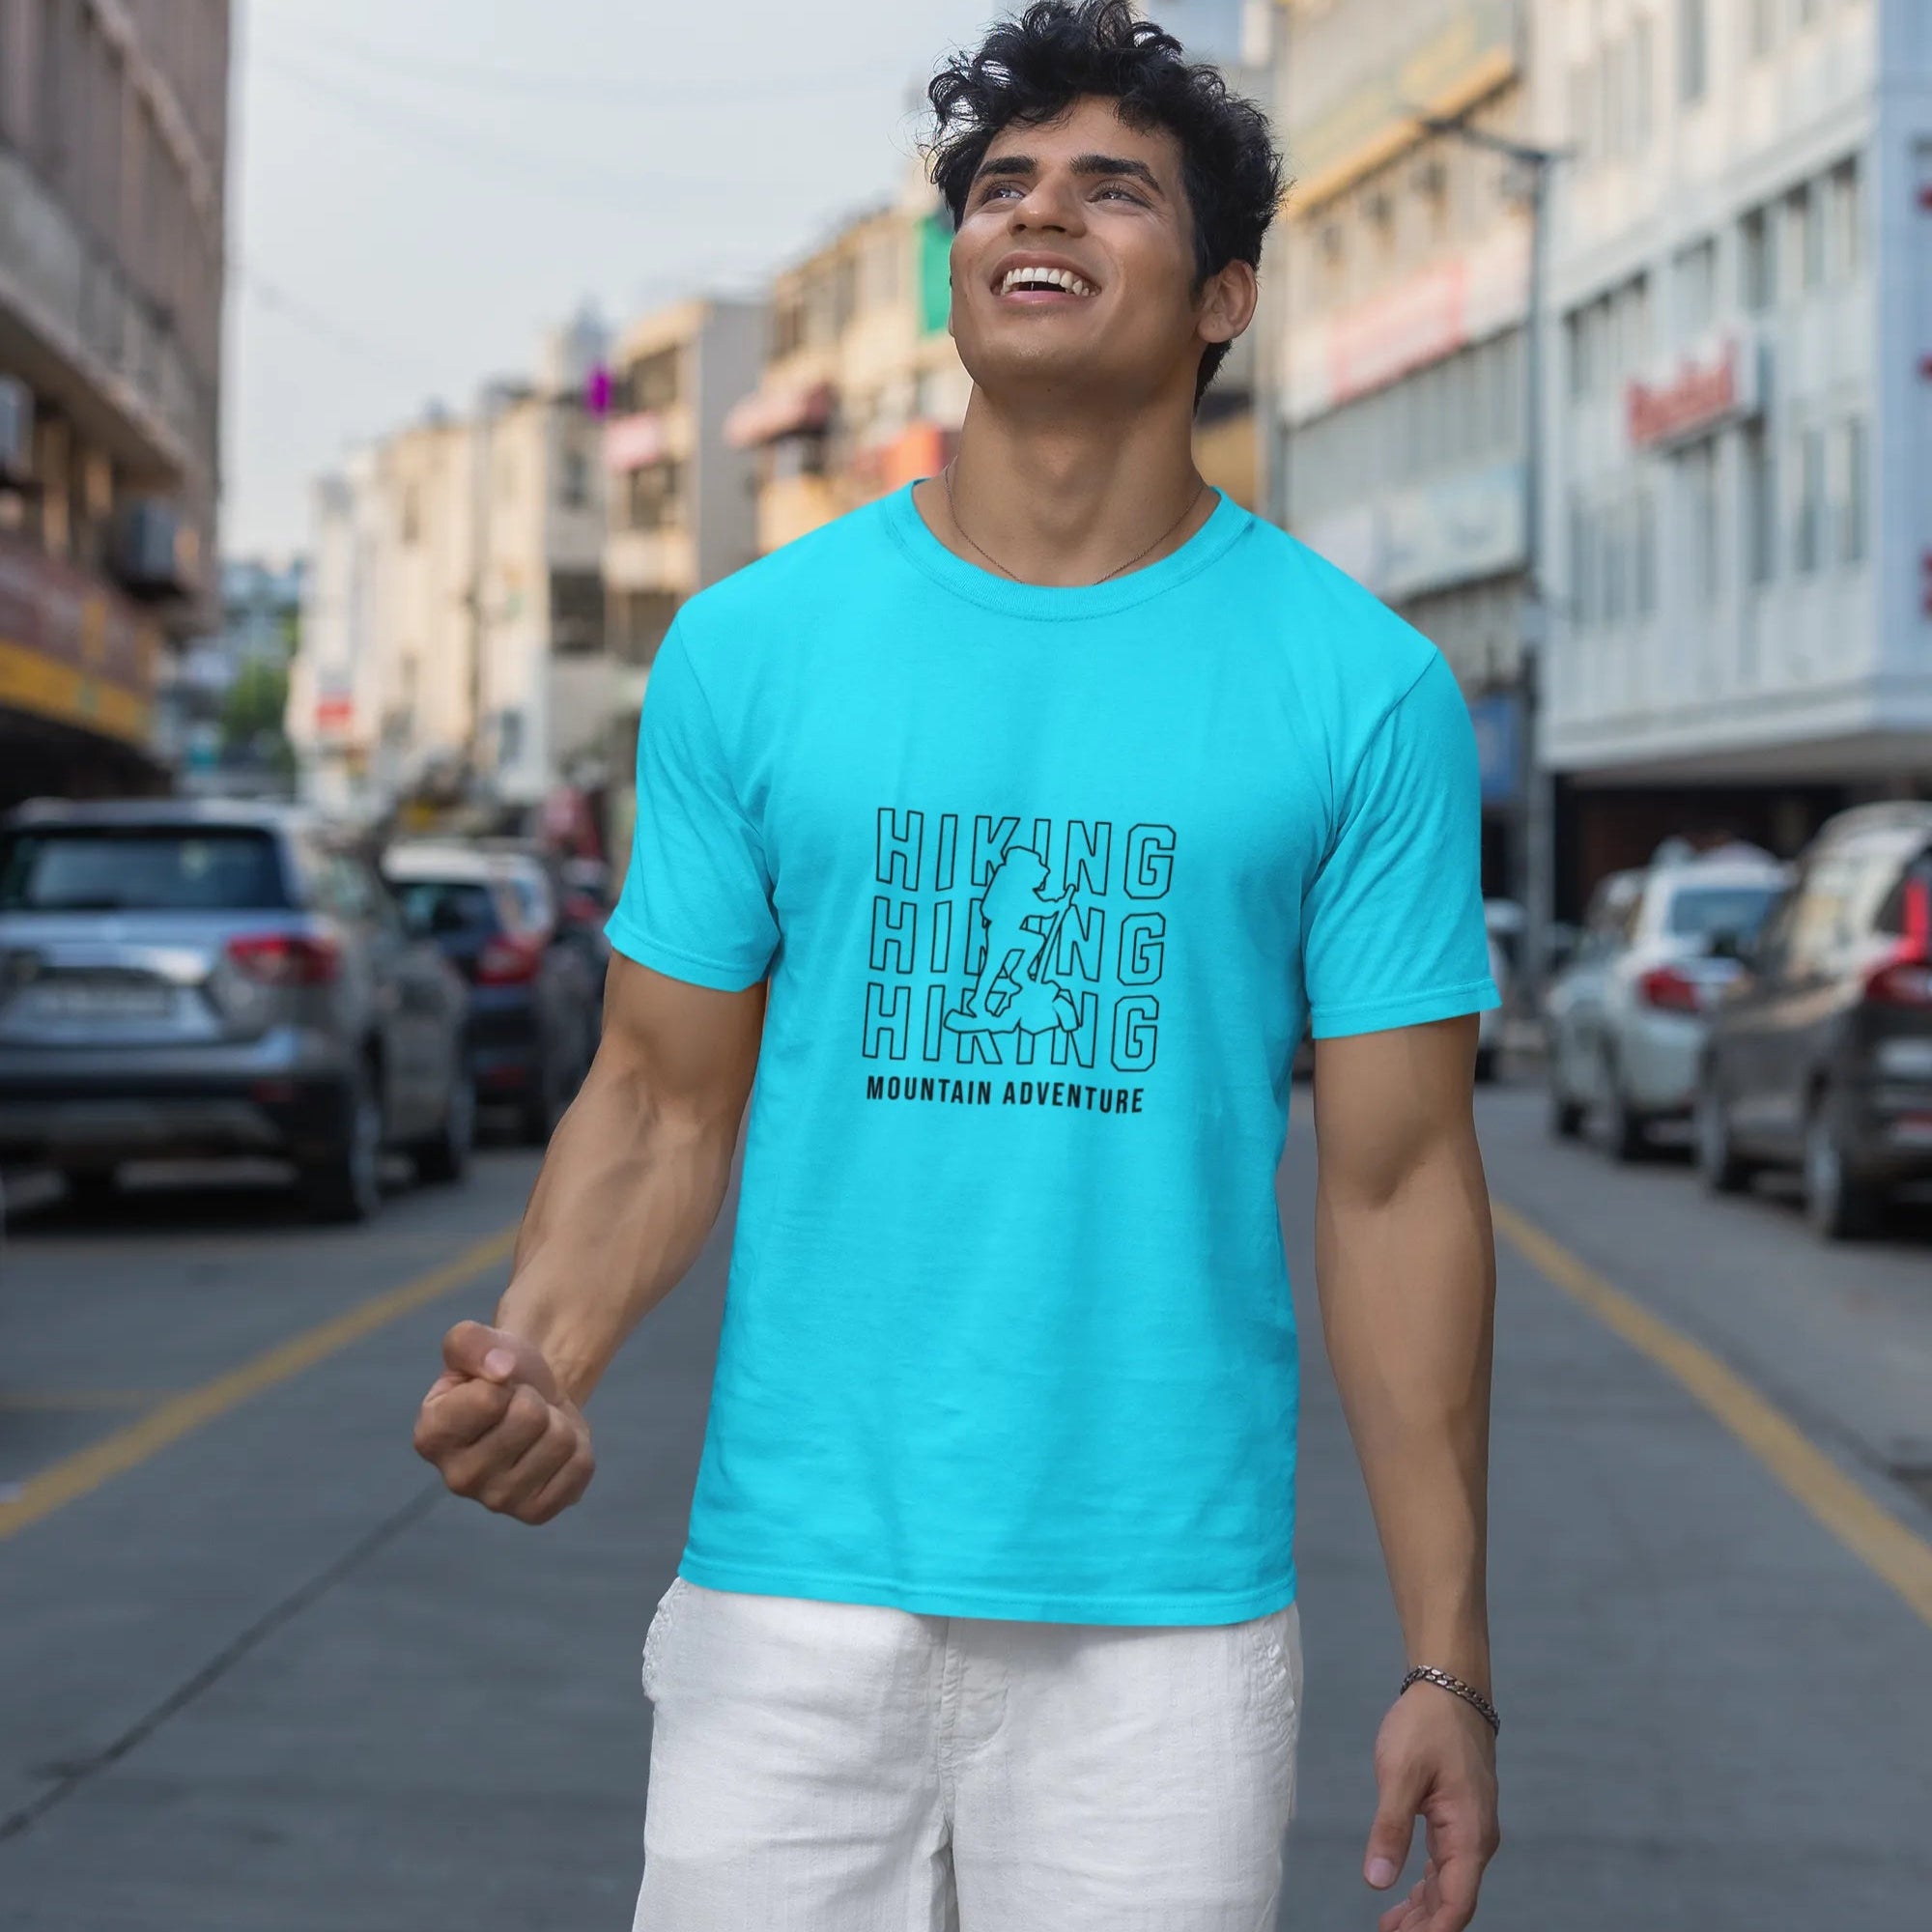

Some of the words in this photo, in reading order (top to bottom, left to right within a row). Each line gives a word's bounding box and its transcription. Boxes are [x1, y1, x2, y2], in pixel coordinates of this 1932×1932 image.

[876, 808, 1177, 900] HIKING
[866, 1075, 992, 1105] MOUNTAIN
[1002, 1080, 1145, 1114] ADVENTURE
